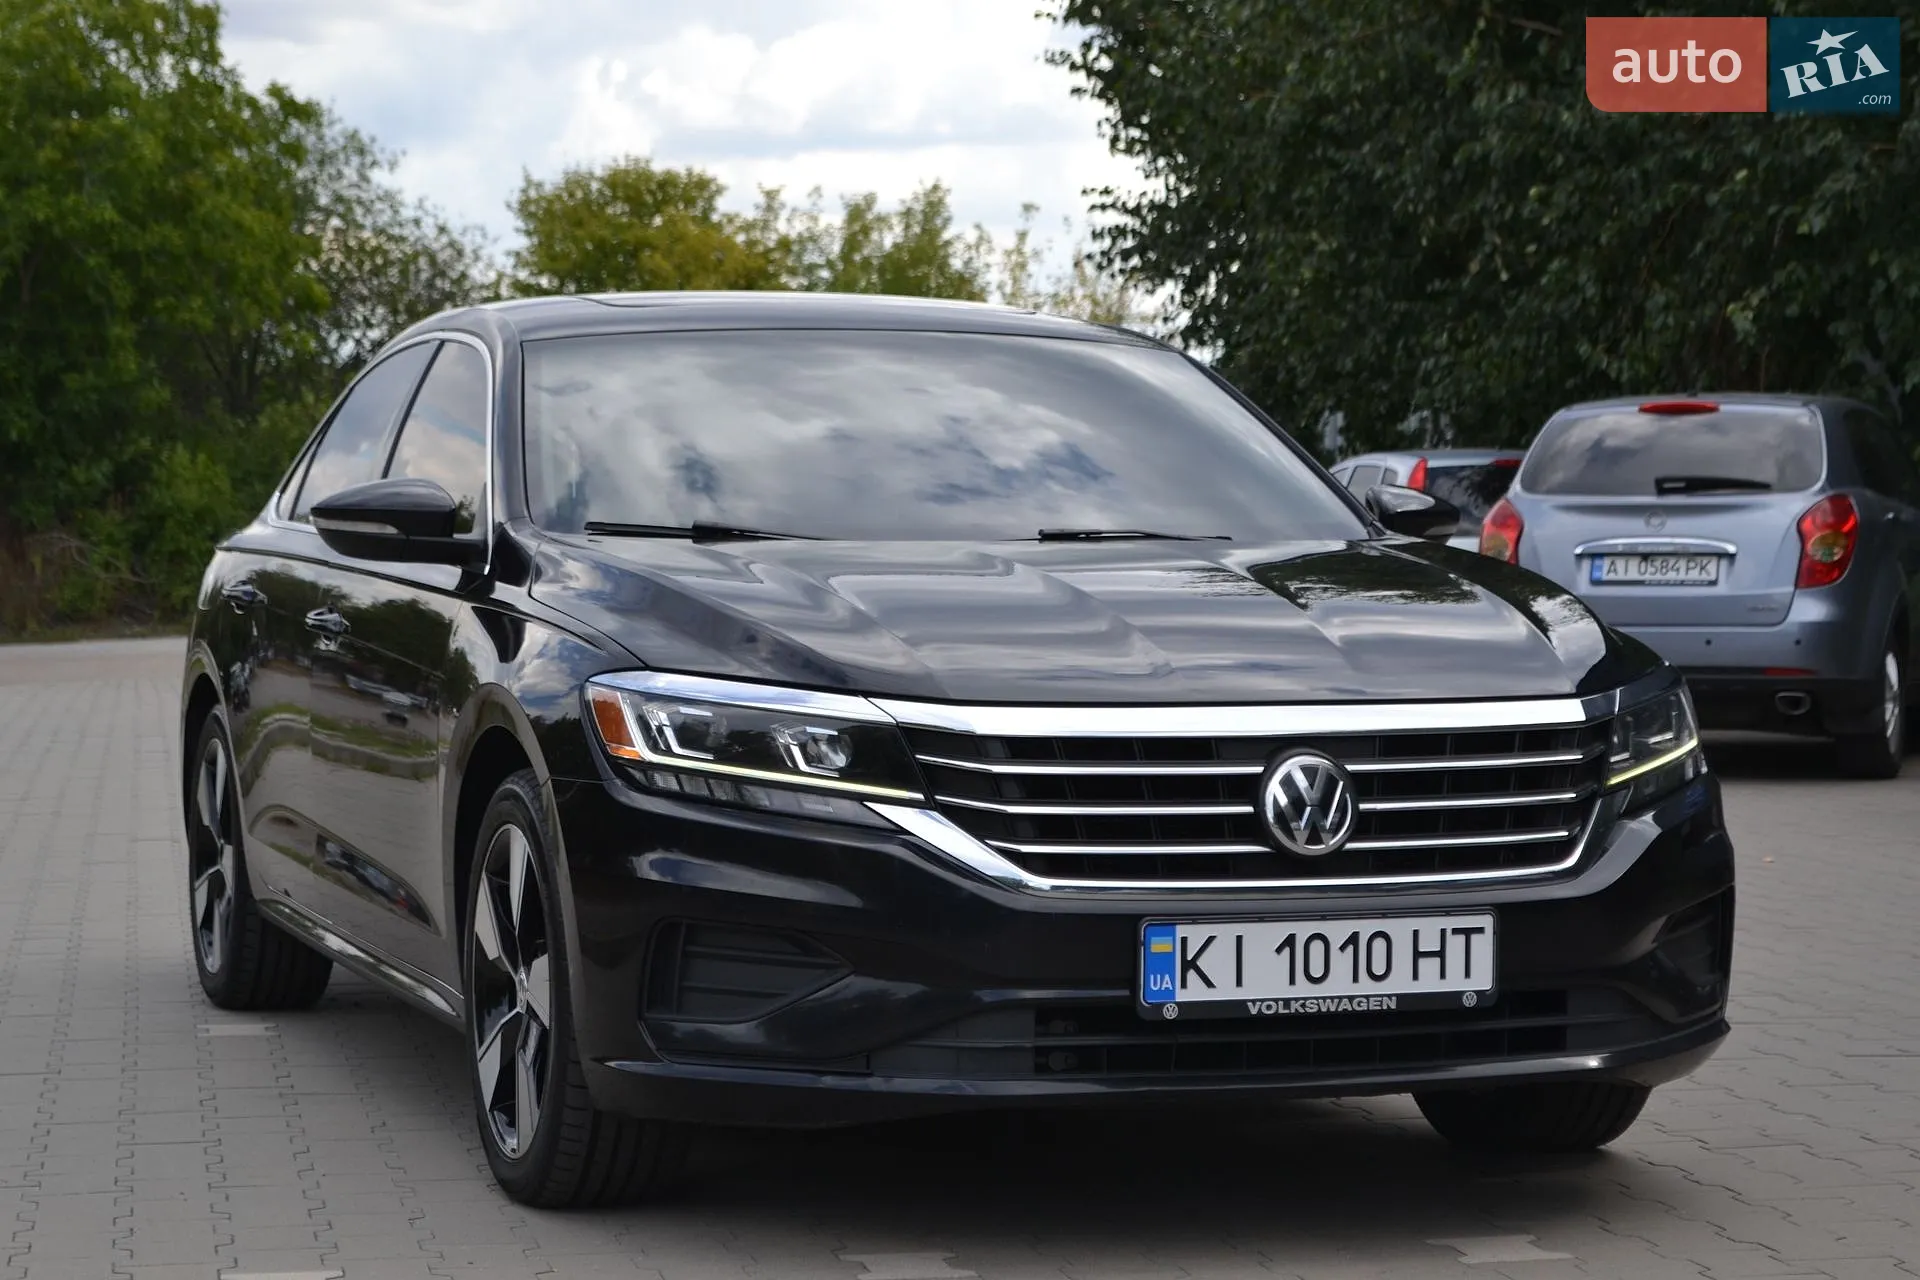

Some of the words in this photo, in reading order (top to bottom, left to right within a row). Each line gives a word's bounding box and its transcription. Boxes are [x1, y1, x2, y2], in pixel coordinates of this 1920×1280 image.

[1638, 559, 1681, 576] 0584
[1685, 559, 1712, 576] PK
[1180, 934, 1244, 990] KI
[1274, 930, 1393, 986] 1010
[1412, 926, 1486, 981] HT
[1150, 973, 1173, 991] UA
[1247, 996, 1397, 1016] VOLKSWAGEN
